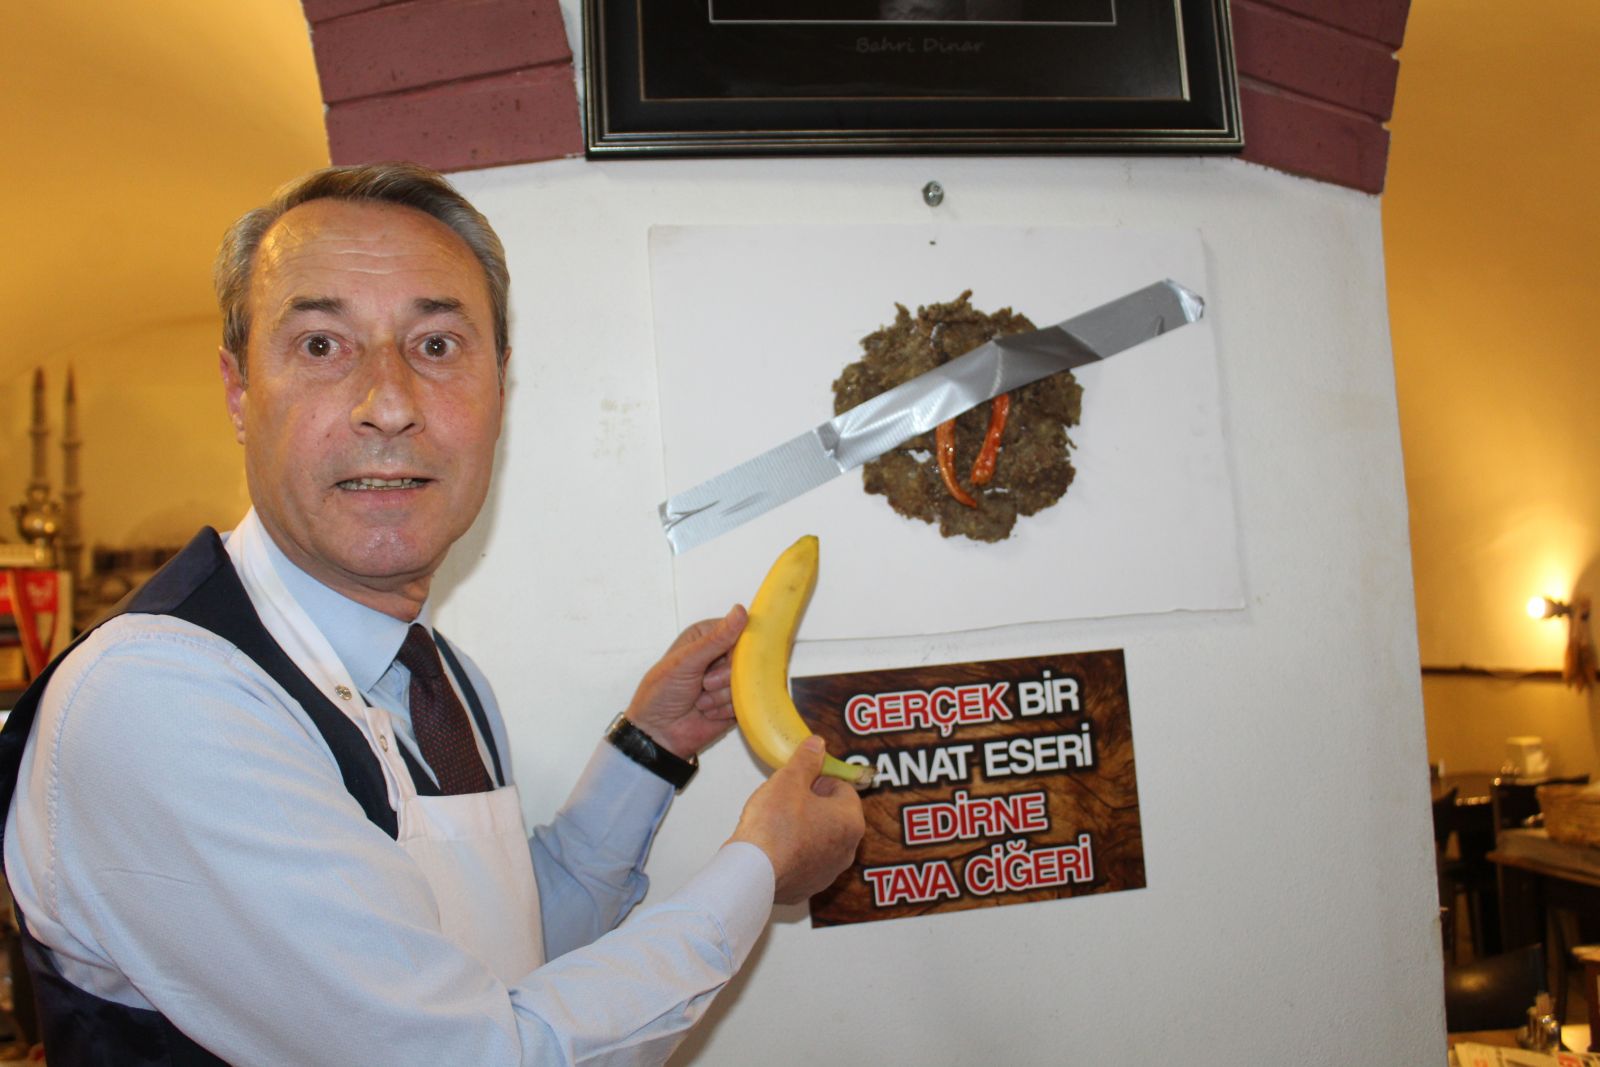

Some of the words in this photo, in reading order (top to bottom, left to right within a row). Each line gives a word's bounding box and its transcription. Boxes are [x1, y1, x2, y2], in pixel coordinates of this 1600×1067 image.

[856, 36, 915, 53] Bahri
[923, 36, 983, 54] Dinar
[846, 683, 1011, 736] GERÇEK
[1019, 671, 1079, 716] BİR
[984, 724, 1093, 777] ESERİ
[904, 791, 1047, 844] EDİRNE
[865, 862, 959, 905] TAVA
[965, 835, 1093, 894] CİĞERİ
